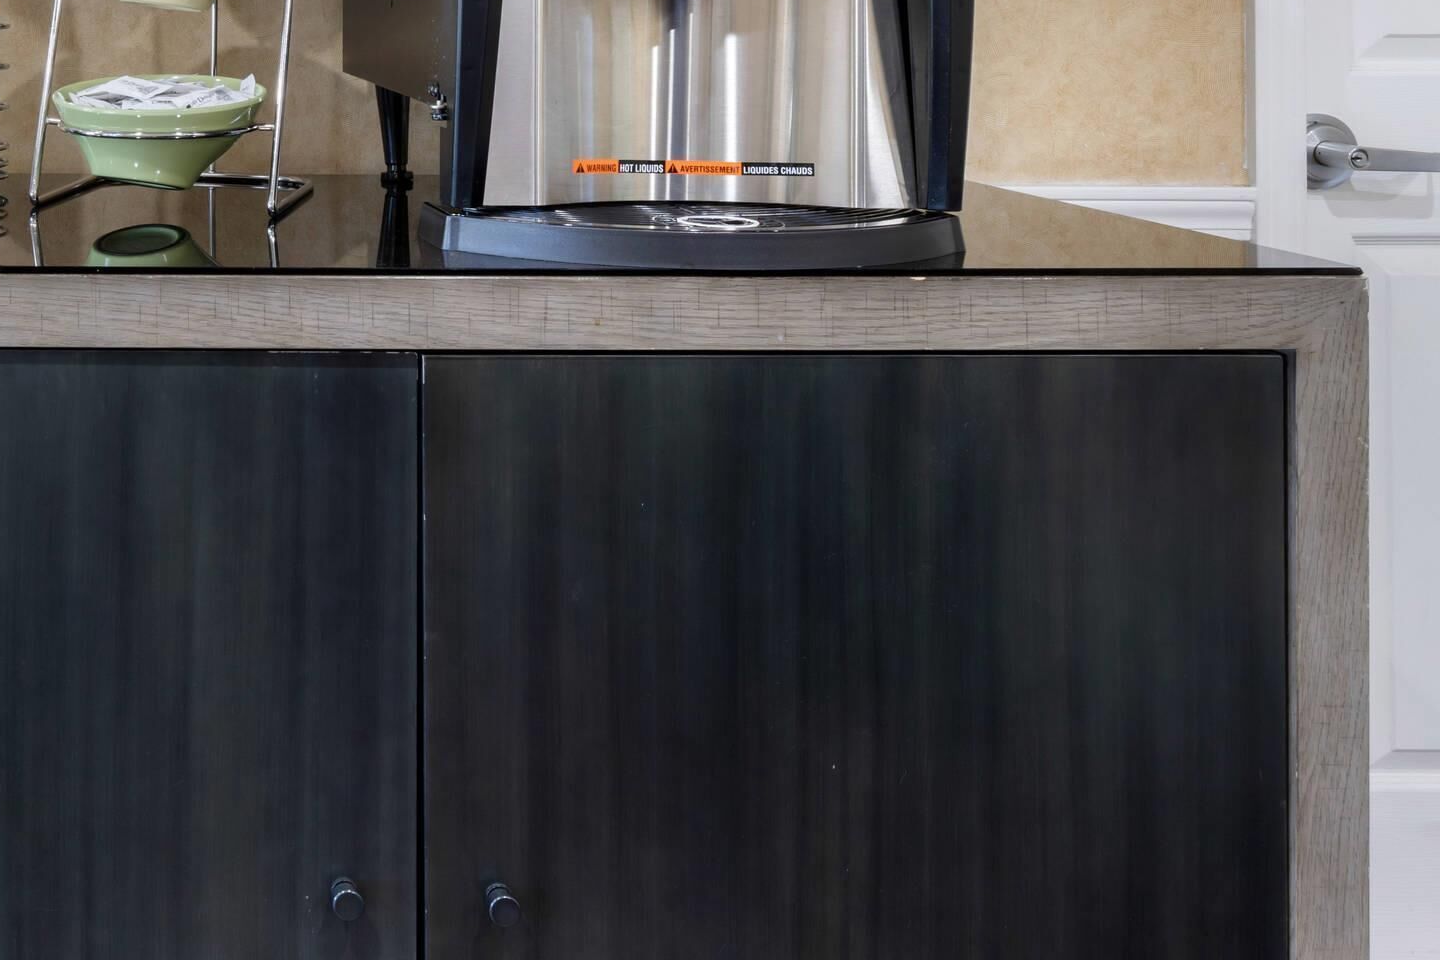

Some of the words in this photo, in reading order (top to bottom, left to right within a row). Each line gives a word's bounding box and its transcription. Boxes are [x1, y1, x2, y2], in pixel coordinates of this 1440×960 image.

[587, 164, 617, 172] WARNING
[620, 164, 633, 172] HOT
[635, 164, 664, 173] LIQUIDS
[680, 165, 740, 173] AVERTISSEMENT
[743, 166, 779, 174] LIQUIDES
[780, 166, 813, 175] CHAUDS
